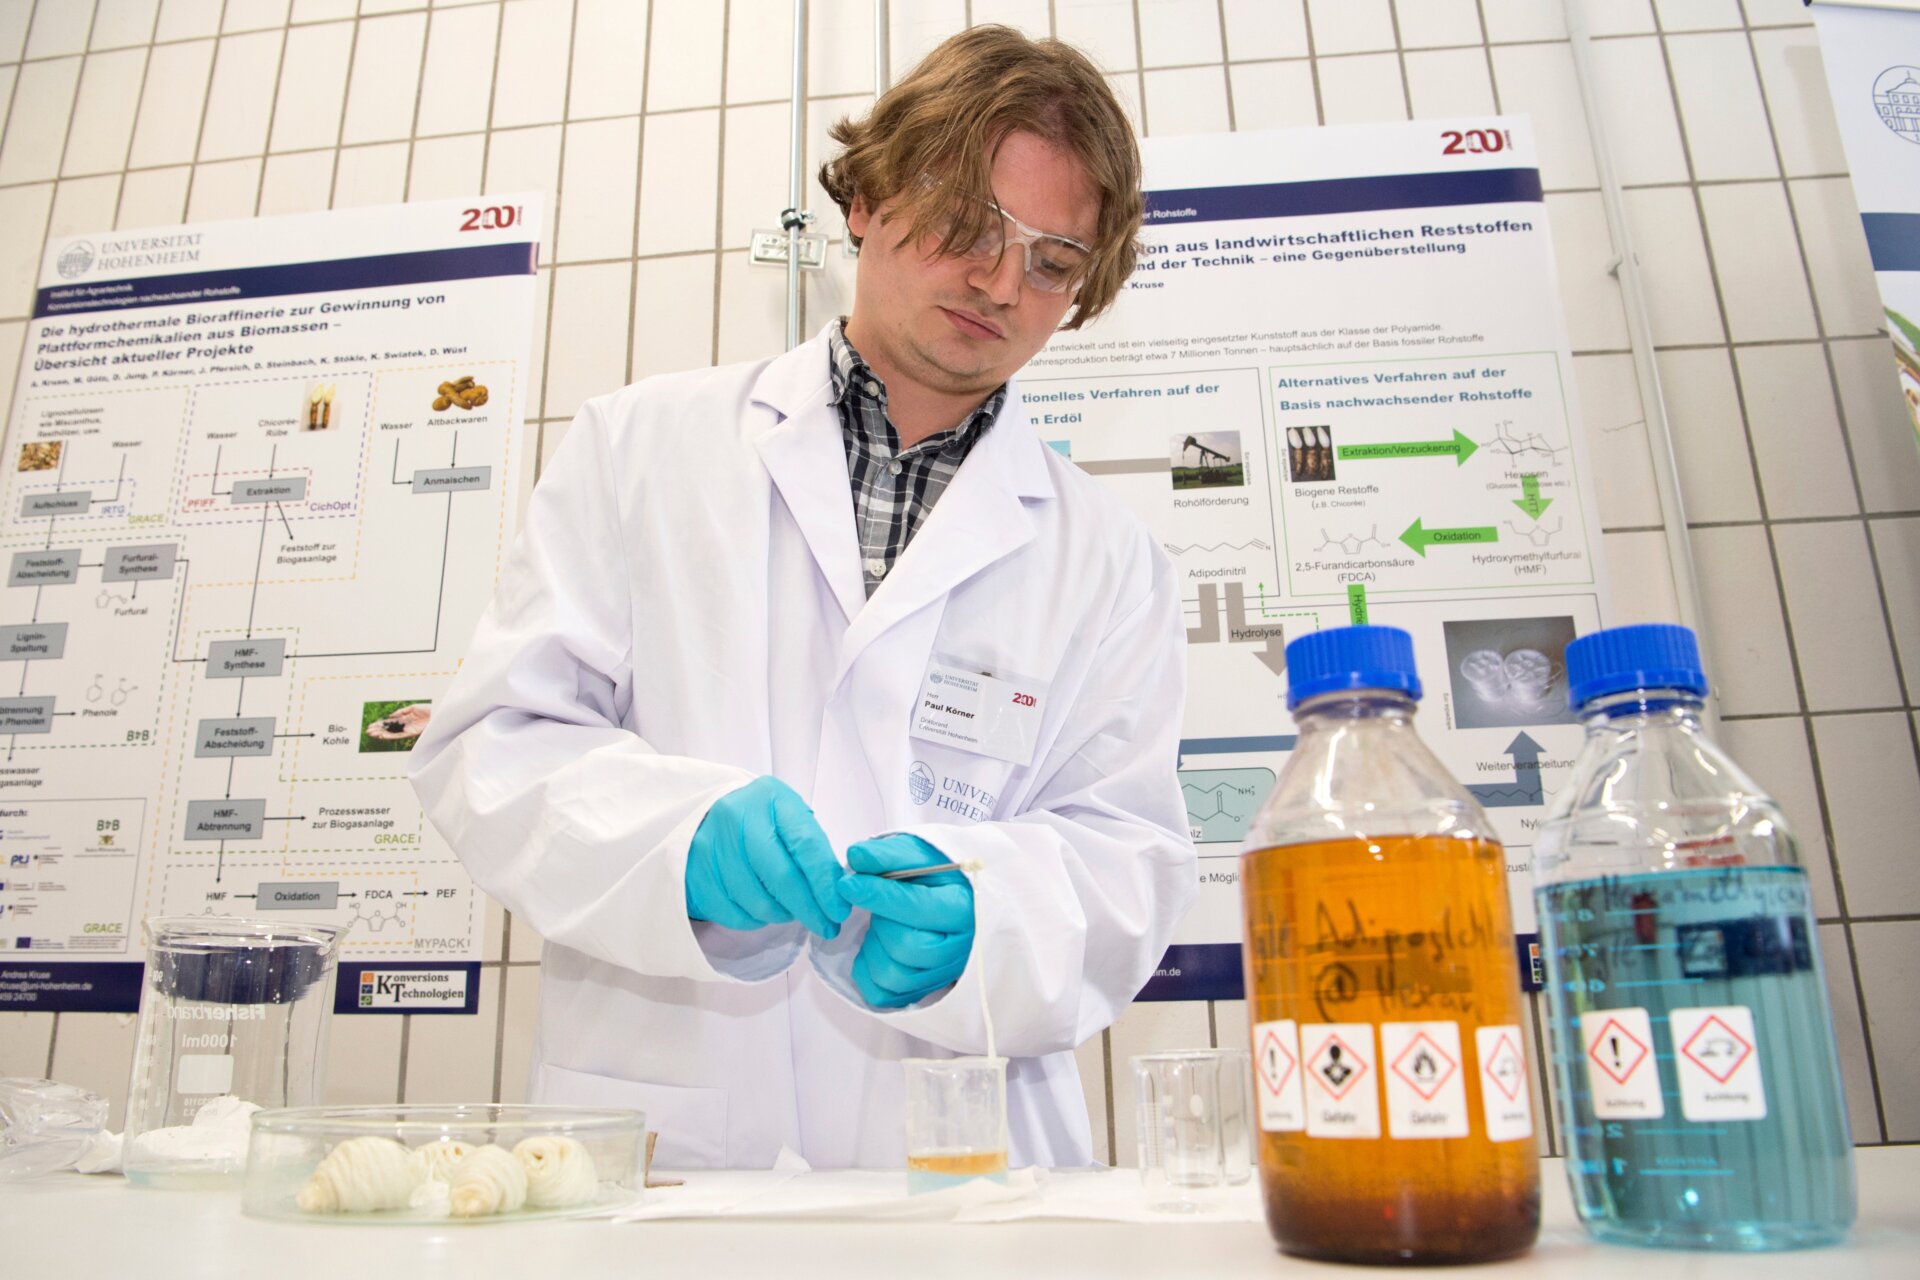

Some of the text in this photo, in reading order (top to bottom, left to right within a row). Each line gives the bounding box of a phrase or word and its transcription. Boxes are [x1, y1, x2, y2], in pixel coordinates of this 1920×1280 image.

[1153, 208, 1197, 218] Rohstoffe
[1175, 220, 1533, 252] aus landwirtschaftlichen Reststoffen
[97, 250, 200, 271] HOHENHEIM
[1161, 242, 1466, 269] der Technik eine Gegenüberstellung
[1131, 281, 1164, 289] Kruse
[41, 294, 446, 338] Die hydrothermale Bioraffinerie zur Gewinnung von
[37, 320, 329, 354] Plattformchemikalien aus Biomassen
[1049, 342, 1096, 352] entwickelt
[1131, 340, 1146, 348] ein
[1148, 337, 1189, 348] vielseitig
[1191, 334, 1248, 345] eingesetzter
[1251, 330, 1298, 341] Kunststoff
[1320, 328, 1336, 337] der
[1339, 327, 1370, 336] Klasse
[1372, 325, 1388, 334] der
[1391, 323, 1443, 333] Polyamide.
[1029, 334, 1484, 367] Jahresproduktion beträgt etwa 7 Millionen Tonnen hauptsächlich auf der Basis fossiler Rohstoffe
[34, 343, 254, 371] Übersicht aktueller Projekte
[266, 359, 318, 369] Steinbach,
[370, 352, 381, 360] K.
[384, 349, 426, 359] Swiatek,
[429, 348, 440, 356] D.
[442, 346, 468, 355] Wüst
[1278, 368, 1506, 388] Alternatives Verfahren auf der
[1090, 388, 1162, 400] Verfahren
[1167, 385, 1190, 396] auf
[1196, 383, 1219, 394] der
[1280, 388, 1533, 411] Basis nachwachsender Rohstoffe
[427, 415, 488, 427] Altbackwaren
[1044, 413, 1082, 424] Erdöl
[381, 422, 413, 431] Wasser
[206, 431, 238, 440] Wasser
[265, 428, 288, 438] Rübe
[111, 440, 143, 449] Wasser
[1342, 443, 1461, 456] Extraktion/Verzuckerung
[423, 475, 481, 486] Anmaischen
[1504, 470, 1548, 480] Hexosen
[247, 486, 291, 497] Extraktion
[1294, 484, 1379, 498] Biogene Restoffe
[310, 501, 352, 513] CichOpt
[1173, 497, 1249, 509] Rohölförderung
[1433, 531, 1481, 542] Oxidation
[280, 542, 336, 553] Feststoff zur
[121, 554, 159, 563] Furfural-
[276, 553, 337, 566] Biogasanlage
[1472, 550, 1582, 565] Hydroxymethylfurfural
[119, 564, 158, 575] Synthese
[1295, 557, 1415, 571] 2,5-Furandicarbonsäure
[1188, 567, 1246, 579] Adipodinitril
[1514, 564, 1547, 576] (HMF)
[1337, 572, 1376, 583] (FDCA)
[114, 607, 148, 616] Furfural
[1231, 628, 1281, 640] Hydrolyse
[234, 649, 259, 658] HMF-
[223, 660, 266, 671] Synthese
[82, 709, 118, 717] Phenole
[924, 701, 975, 719] Paul Körner
[920, 716, 948, 728] Doktorand
[214, 727, 259, 737] Feststoff-
[328, 725, 348, 733] Bio-
[204, 739, 265, 750] Abscheidung
[322, 737, 350, 745] Kohle
[1476, 759, 1576, 772] Weiterverarbeitung
[213, 810, 238, 819] HMF-
[318, 806, 391, 816] Prozesswasser
[197, 822, 252, 833] Abtrennung
[312, 818, 395, 831] zur Biogasanlage
[374, 834, 416, 845] GRACE
[206, 892, 227, 900] HMF
[274, 892, 320, 902] Oxidation
[365, 890, 393, 899] FDCA
[437, 889, 457, 898] PEF
[84, 924, 122, 933] GRACE
[414, 938, 465, 949] MYPACK
